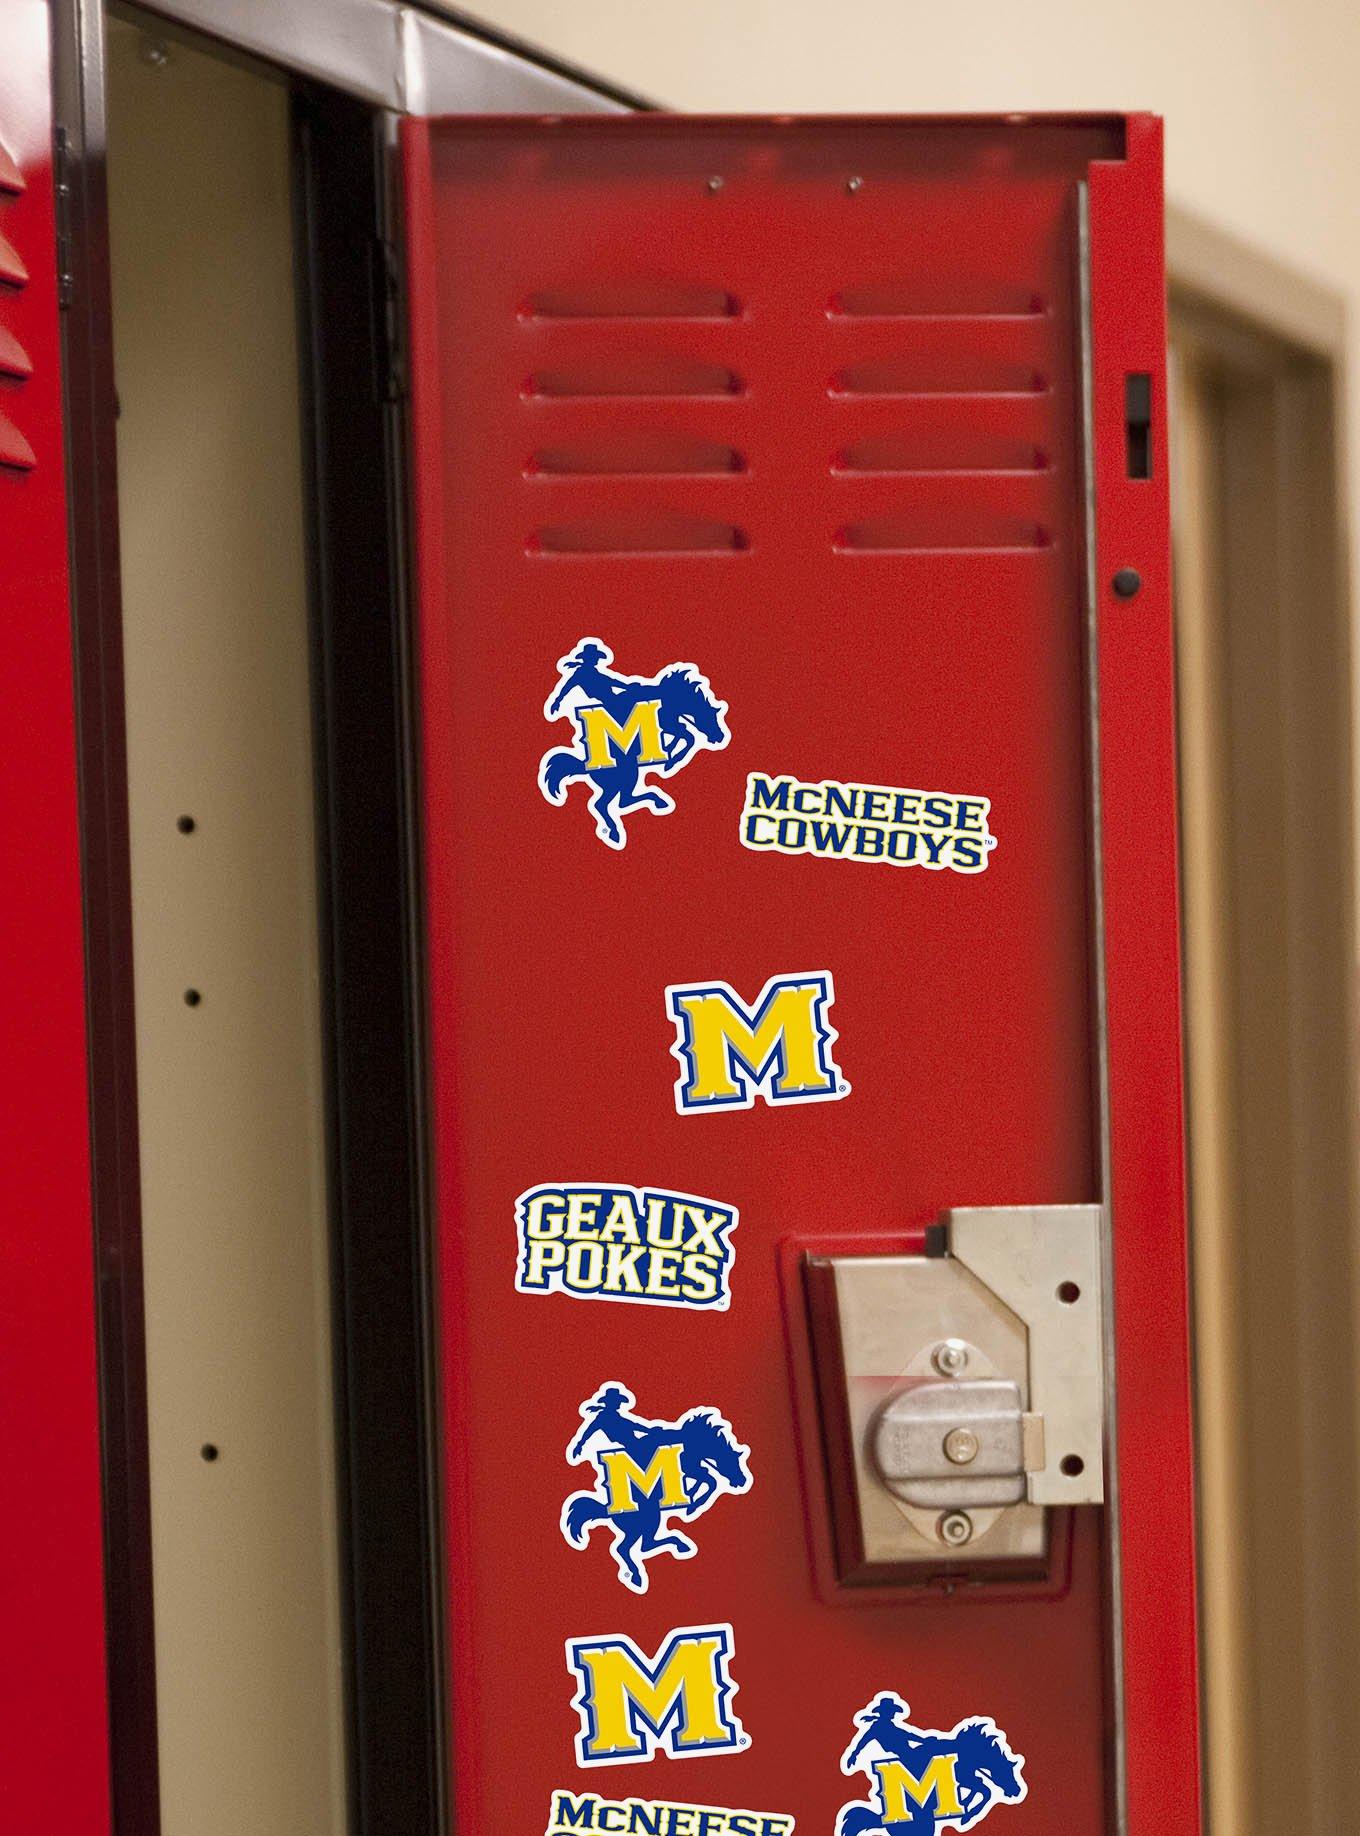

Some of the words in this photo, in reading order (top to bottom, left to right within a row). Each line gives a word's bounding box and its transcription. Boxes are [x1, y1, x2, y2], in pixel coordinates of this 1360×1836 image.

[575, 699, 669, 771] M
[746, 814, 983, 868] COWBOYS
[672, 977, 837, 1109] M
[525, 1193, 728, 1257] GEAUX
[525, 1239, 723, 1300] POKES
[597, 1443, 692, 1515] M
[572, 1630, 737, 1761] M
[871, 1753, 966, 1825] M
